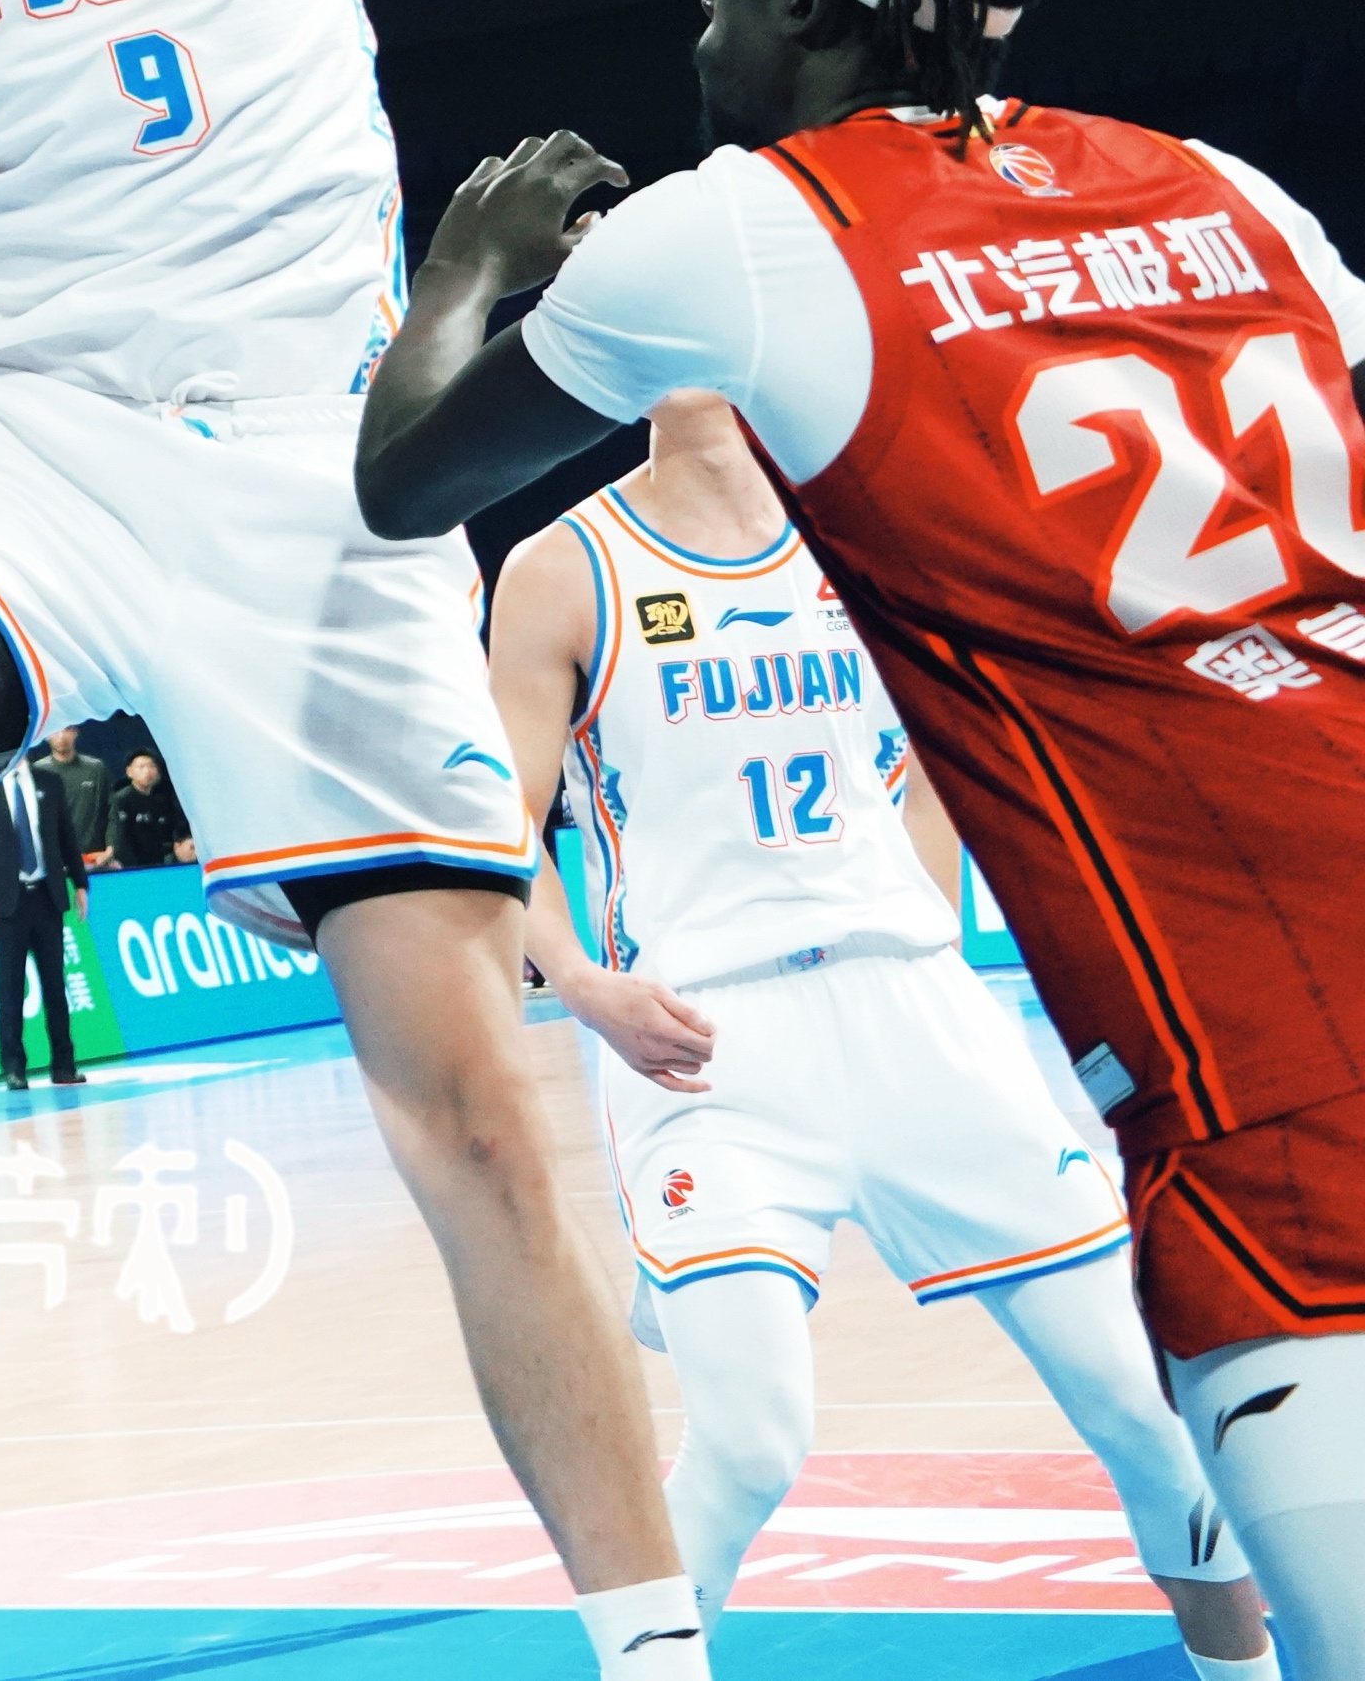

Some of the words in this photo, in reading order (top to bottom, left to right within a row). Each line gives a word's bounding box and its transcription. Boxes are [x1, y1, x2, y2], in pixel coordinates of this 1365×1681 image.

[107, 29, 210, 155] 9
[900, 211, 1269, 344] 北汽极狐
[1012, 331, 1365, 633] 21
[657, 647, 864, 724] FUJIAN
[738, 750, 845, 848] 12
[117, 912, 319, 997] aramc
